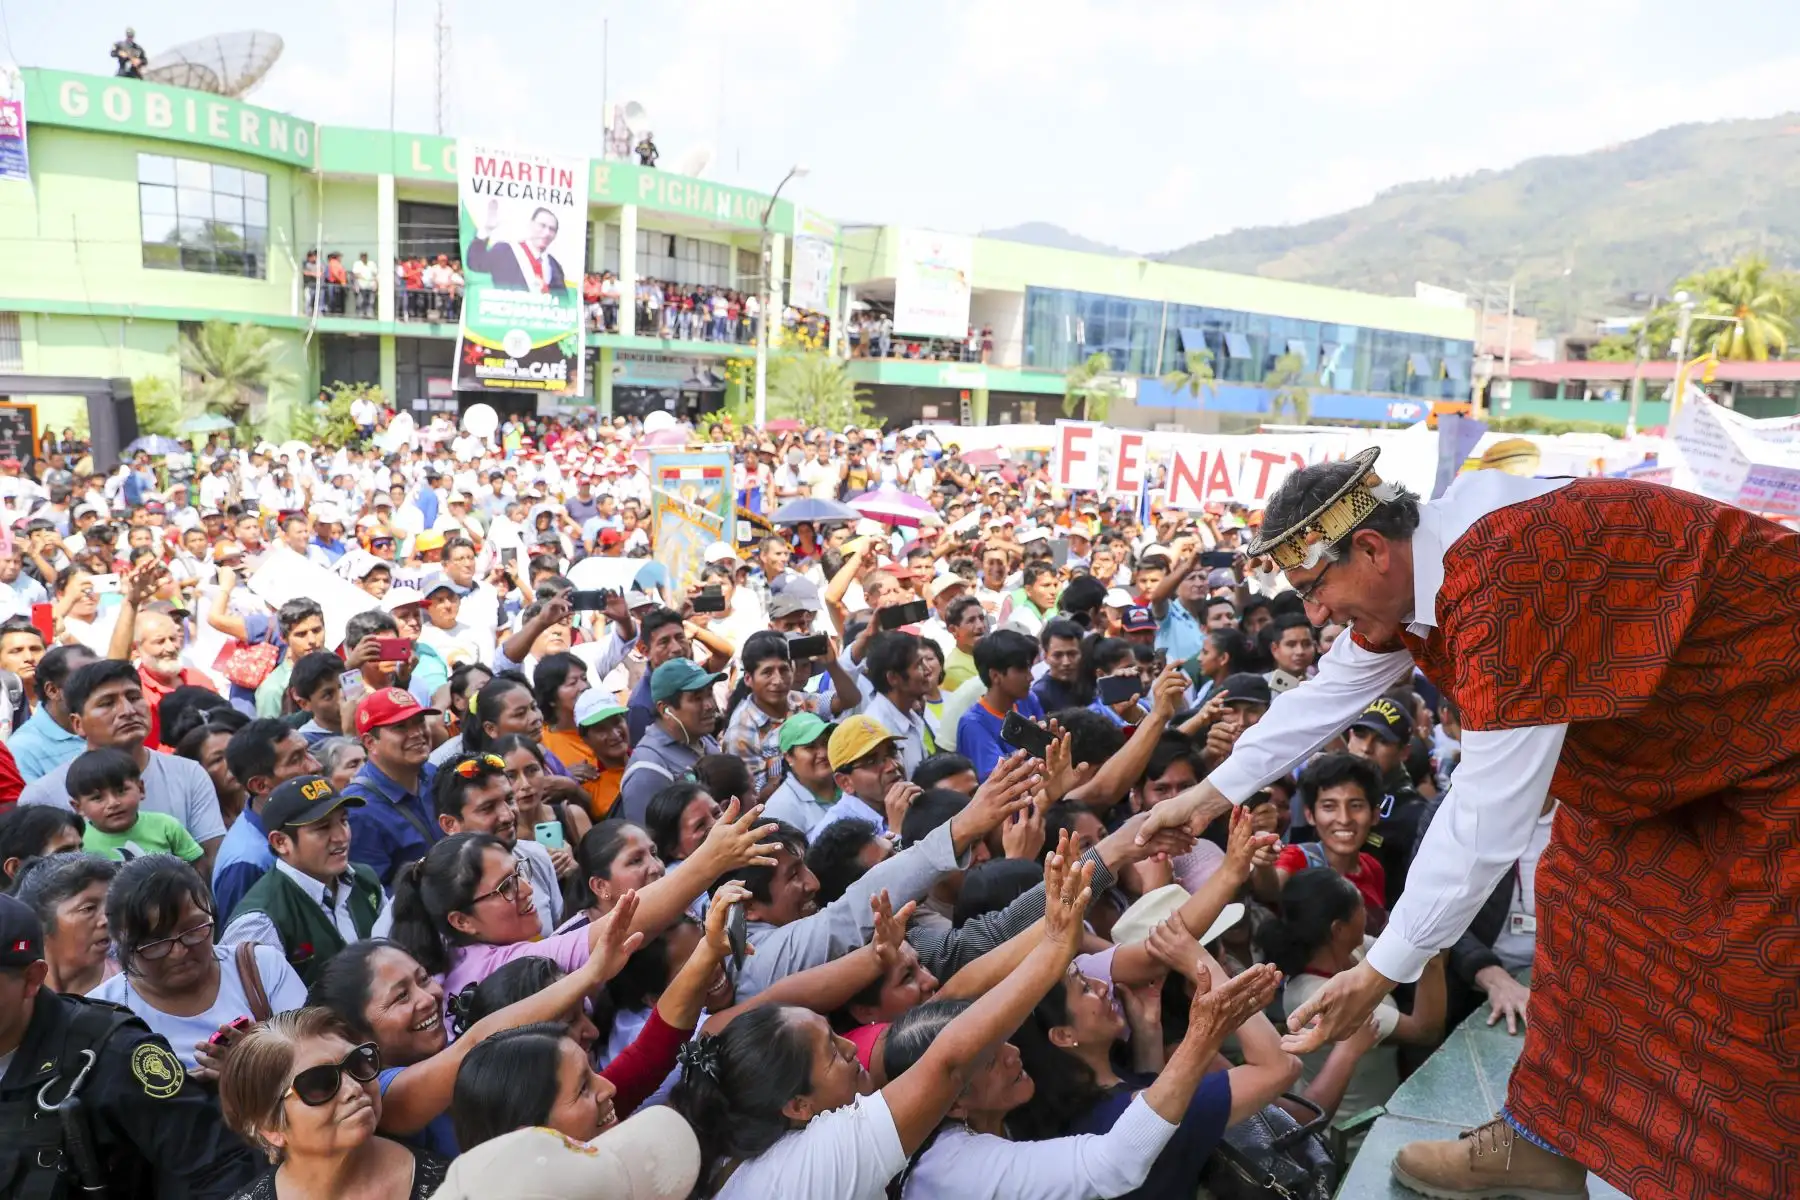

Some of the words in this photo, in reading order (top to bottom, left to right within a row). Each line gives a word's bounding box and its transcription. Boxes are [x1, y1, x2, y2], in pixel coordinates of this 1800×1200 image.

[59, 79, 310, 158] GOBIERNO
[475, 156, 573, 189] MARTIN
[472, 177, 574, 207] VIZCARRA
[529, 359, 567, 380] CAFÉ
